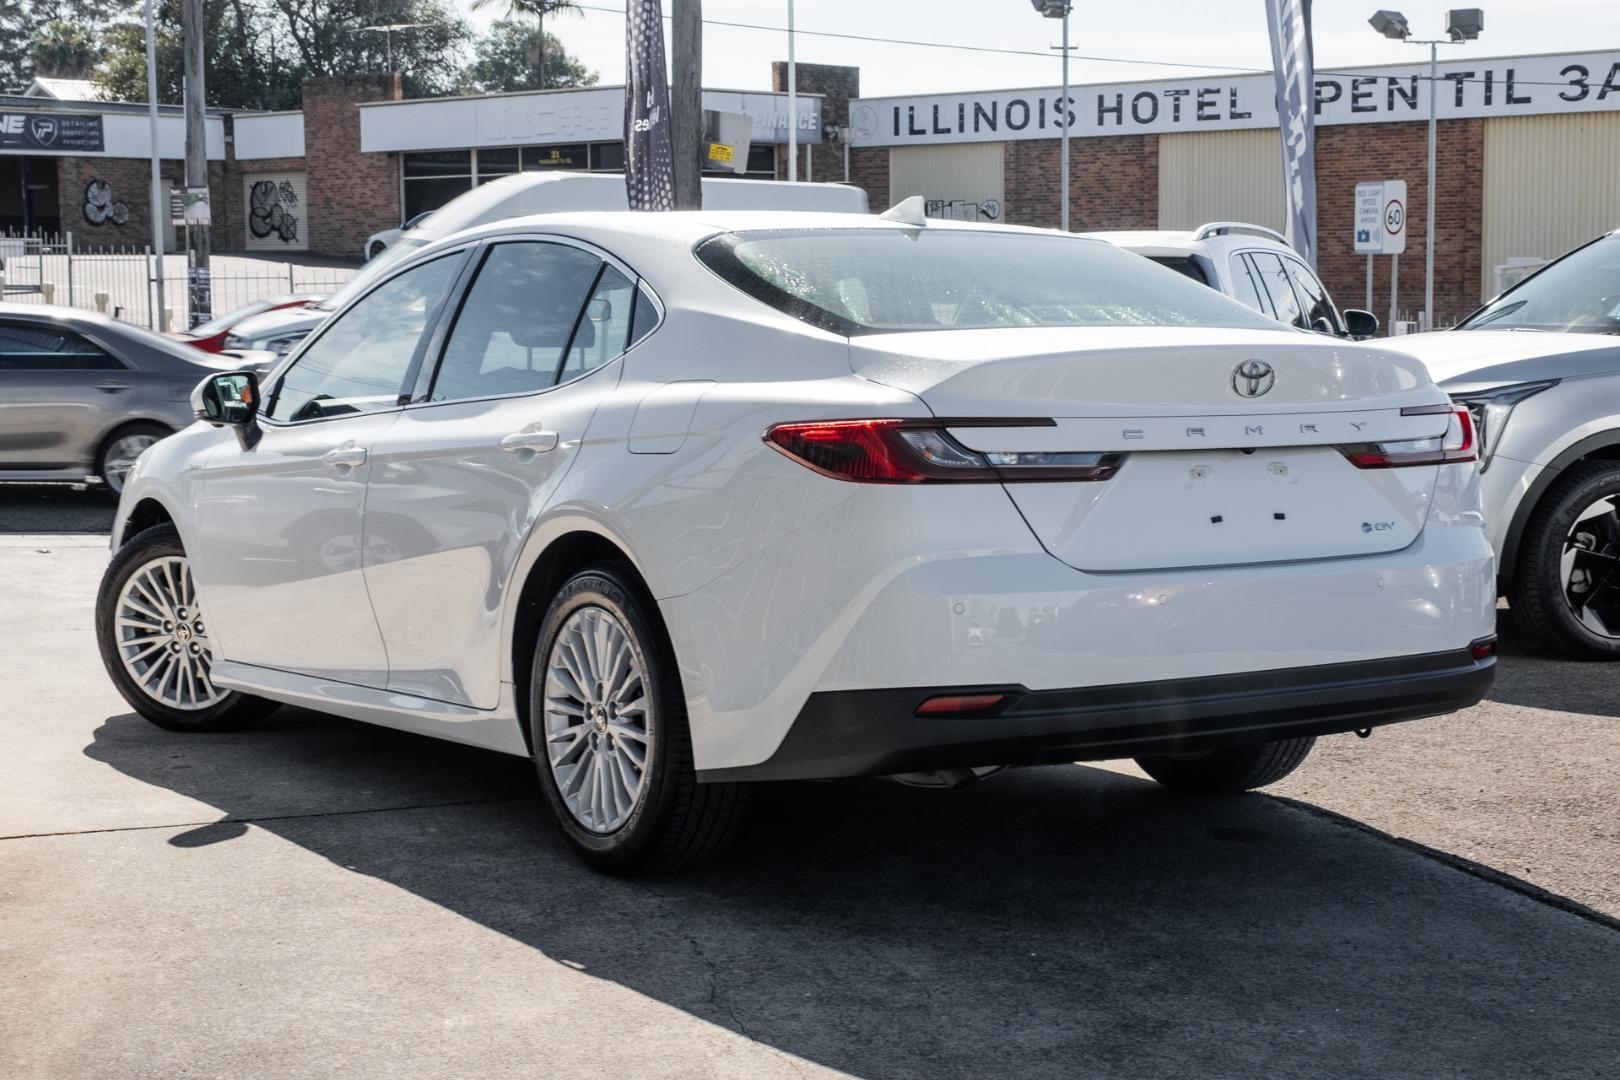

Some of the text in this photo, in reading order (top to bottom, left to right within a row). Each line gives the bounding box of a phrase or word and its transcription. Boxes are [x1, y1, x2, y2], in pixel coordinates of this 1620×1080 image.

[893, 96, 1076, 136] ILLINOIS
[1097, 86, 1252, 126] HOTEL
[1275, 75, 1418, 115] PEN
[1444, 69, 1532, 107] TIL
[1388, 209, 1401, 225] 60
[1122, 422, 1367, 440] CAMRY
